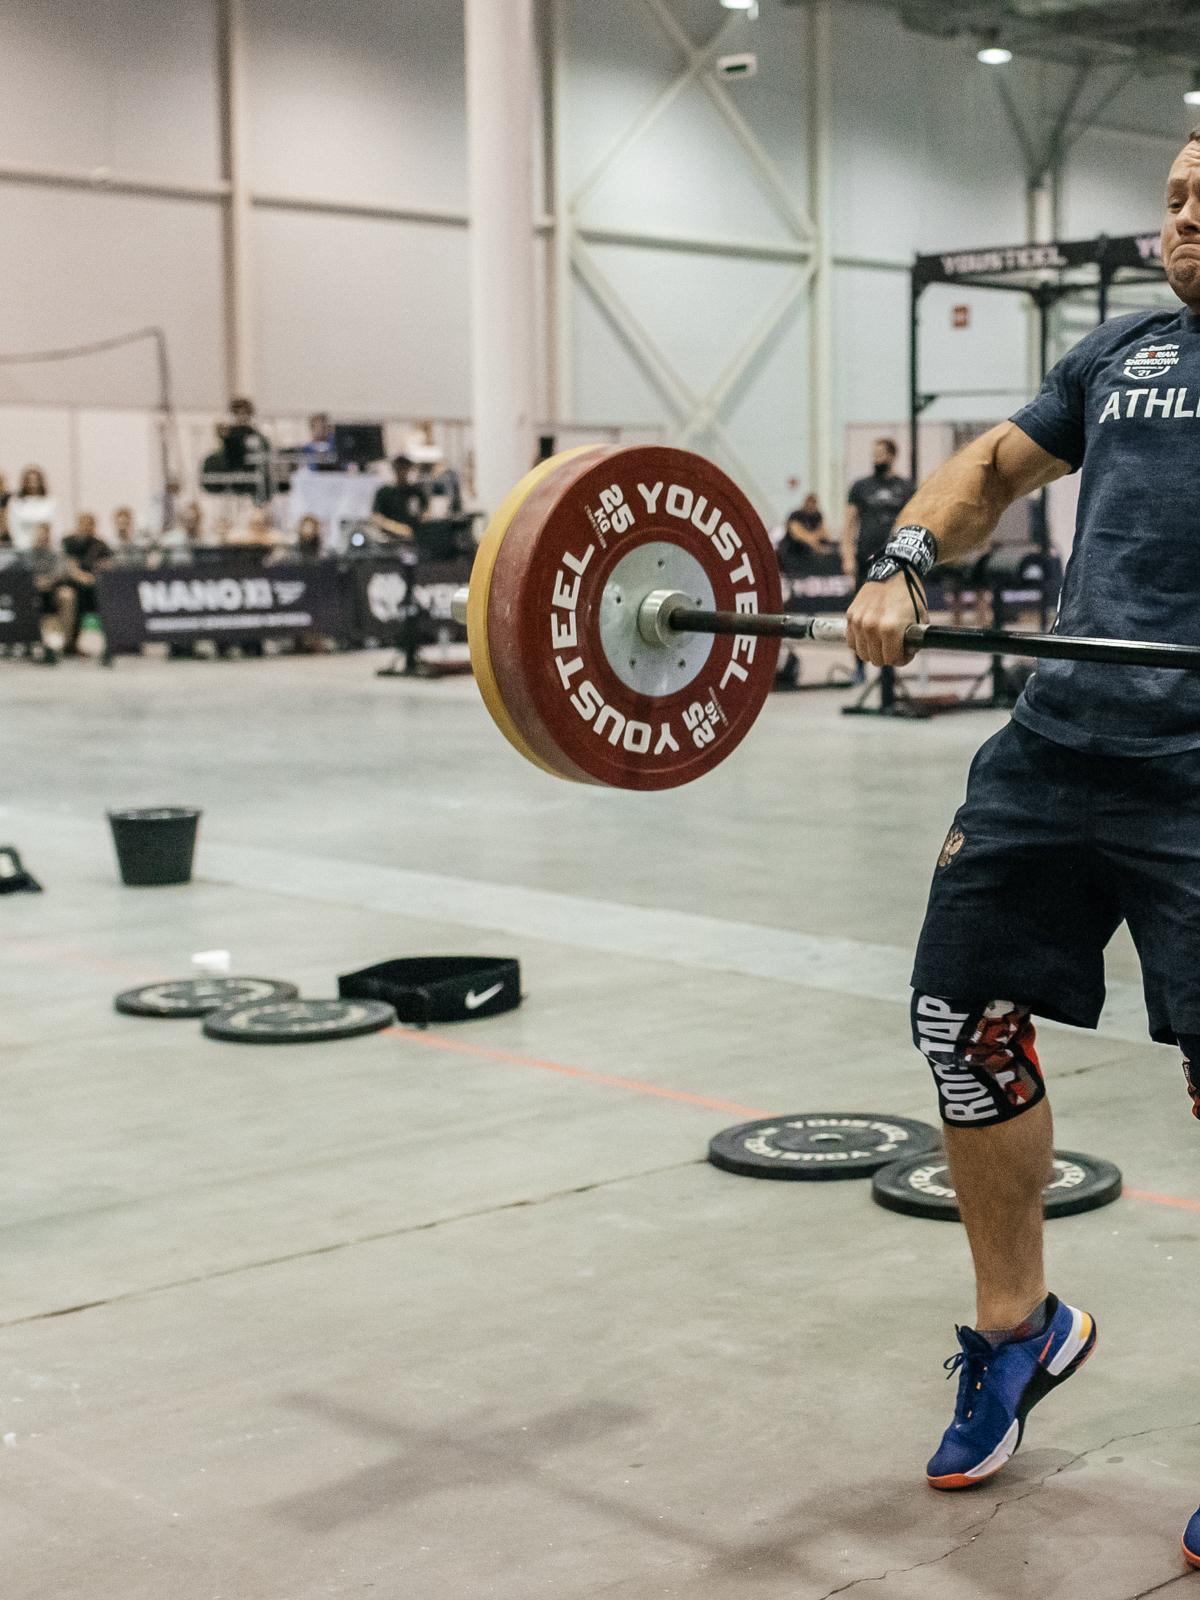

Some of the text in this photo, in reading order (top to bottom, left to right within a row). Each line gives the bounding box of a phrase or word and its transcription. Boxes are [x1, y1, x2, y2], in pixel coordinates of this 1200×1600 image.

[594, 507, 611, 534] KG
[599, 484, 636, 534] 25
[637, 481, 759, 690] YOUSTEEL
[550, 544, 680, 755] YOUSTEEL
[681, 701, 716, 749] 25
[704, 700, 720, 726] KG
